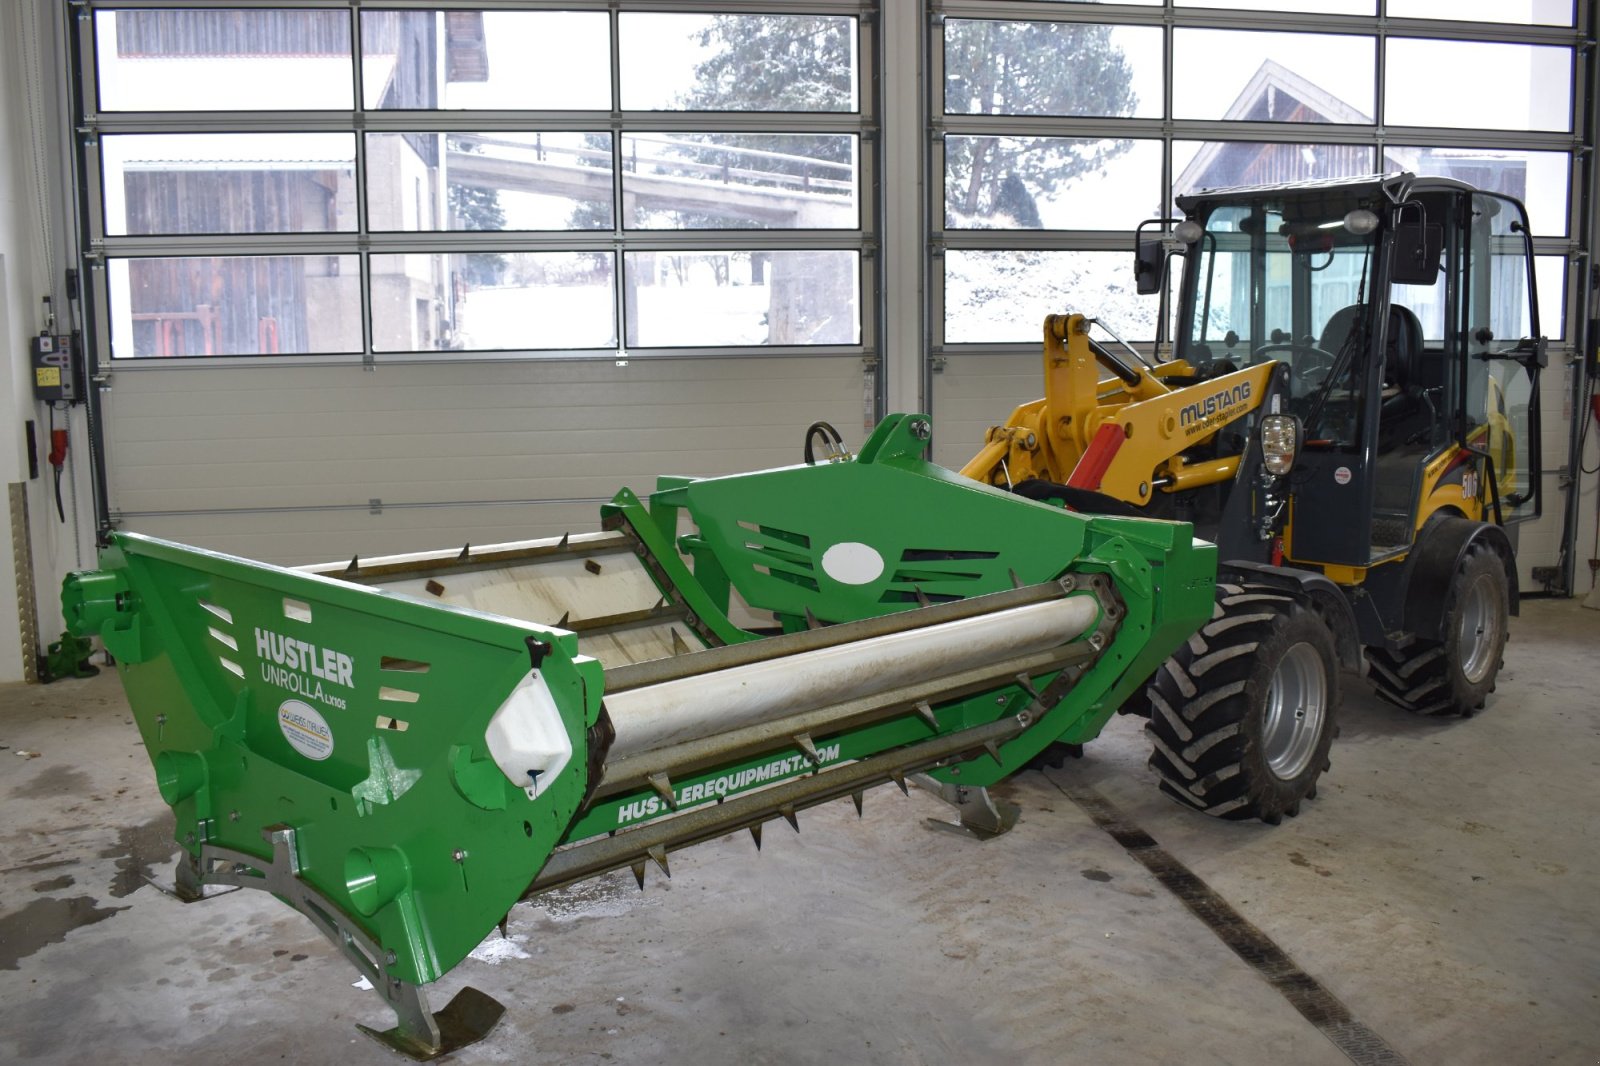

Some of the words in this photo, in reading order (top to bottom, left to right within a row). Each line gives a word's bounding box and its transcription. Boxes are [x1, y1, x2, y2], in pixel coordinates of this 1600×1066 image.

[255, 627, 355, 689] HUSTLER
[261, 662, 324, 703] UNROLLA
[325, 694, 347, 710] LX105
